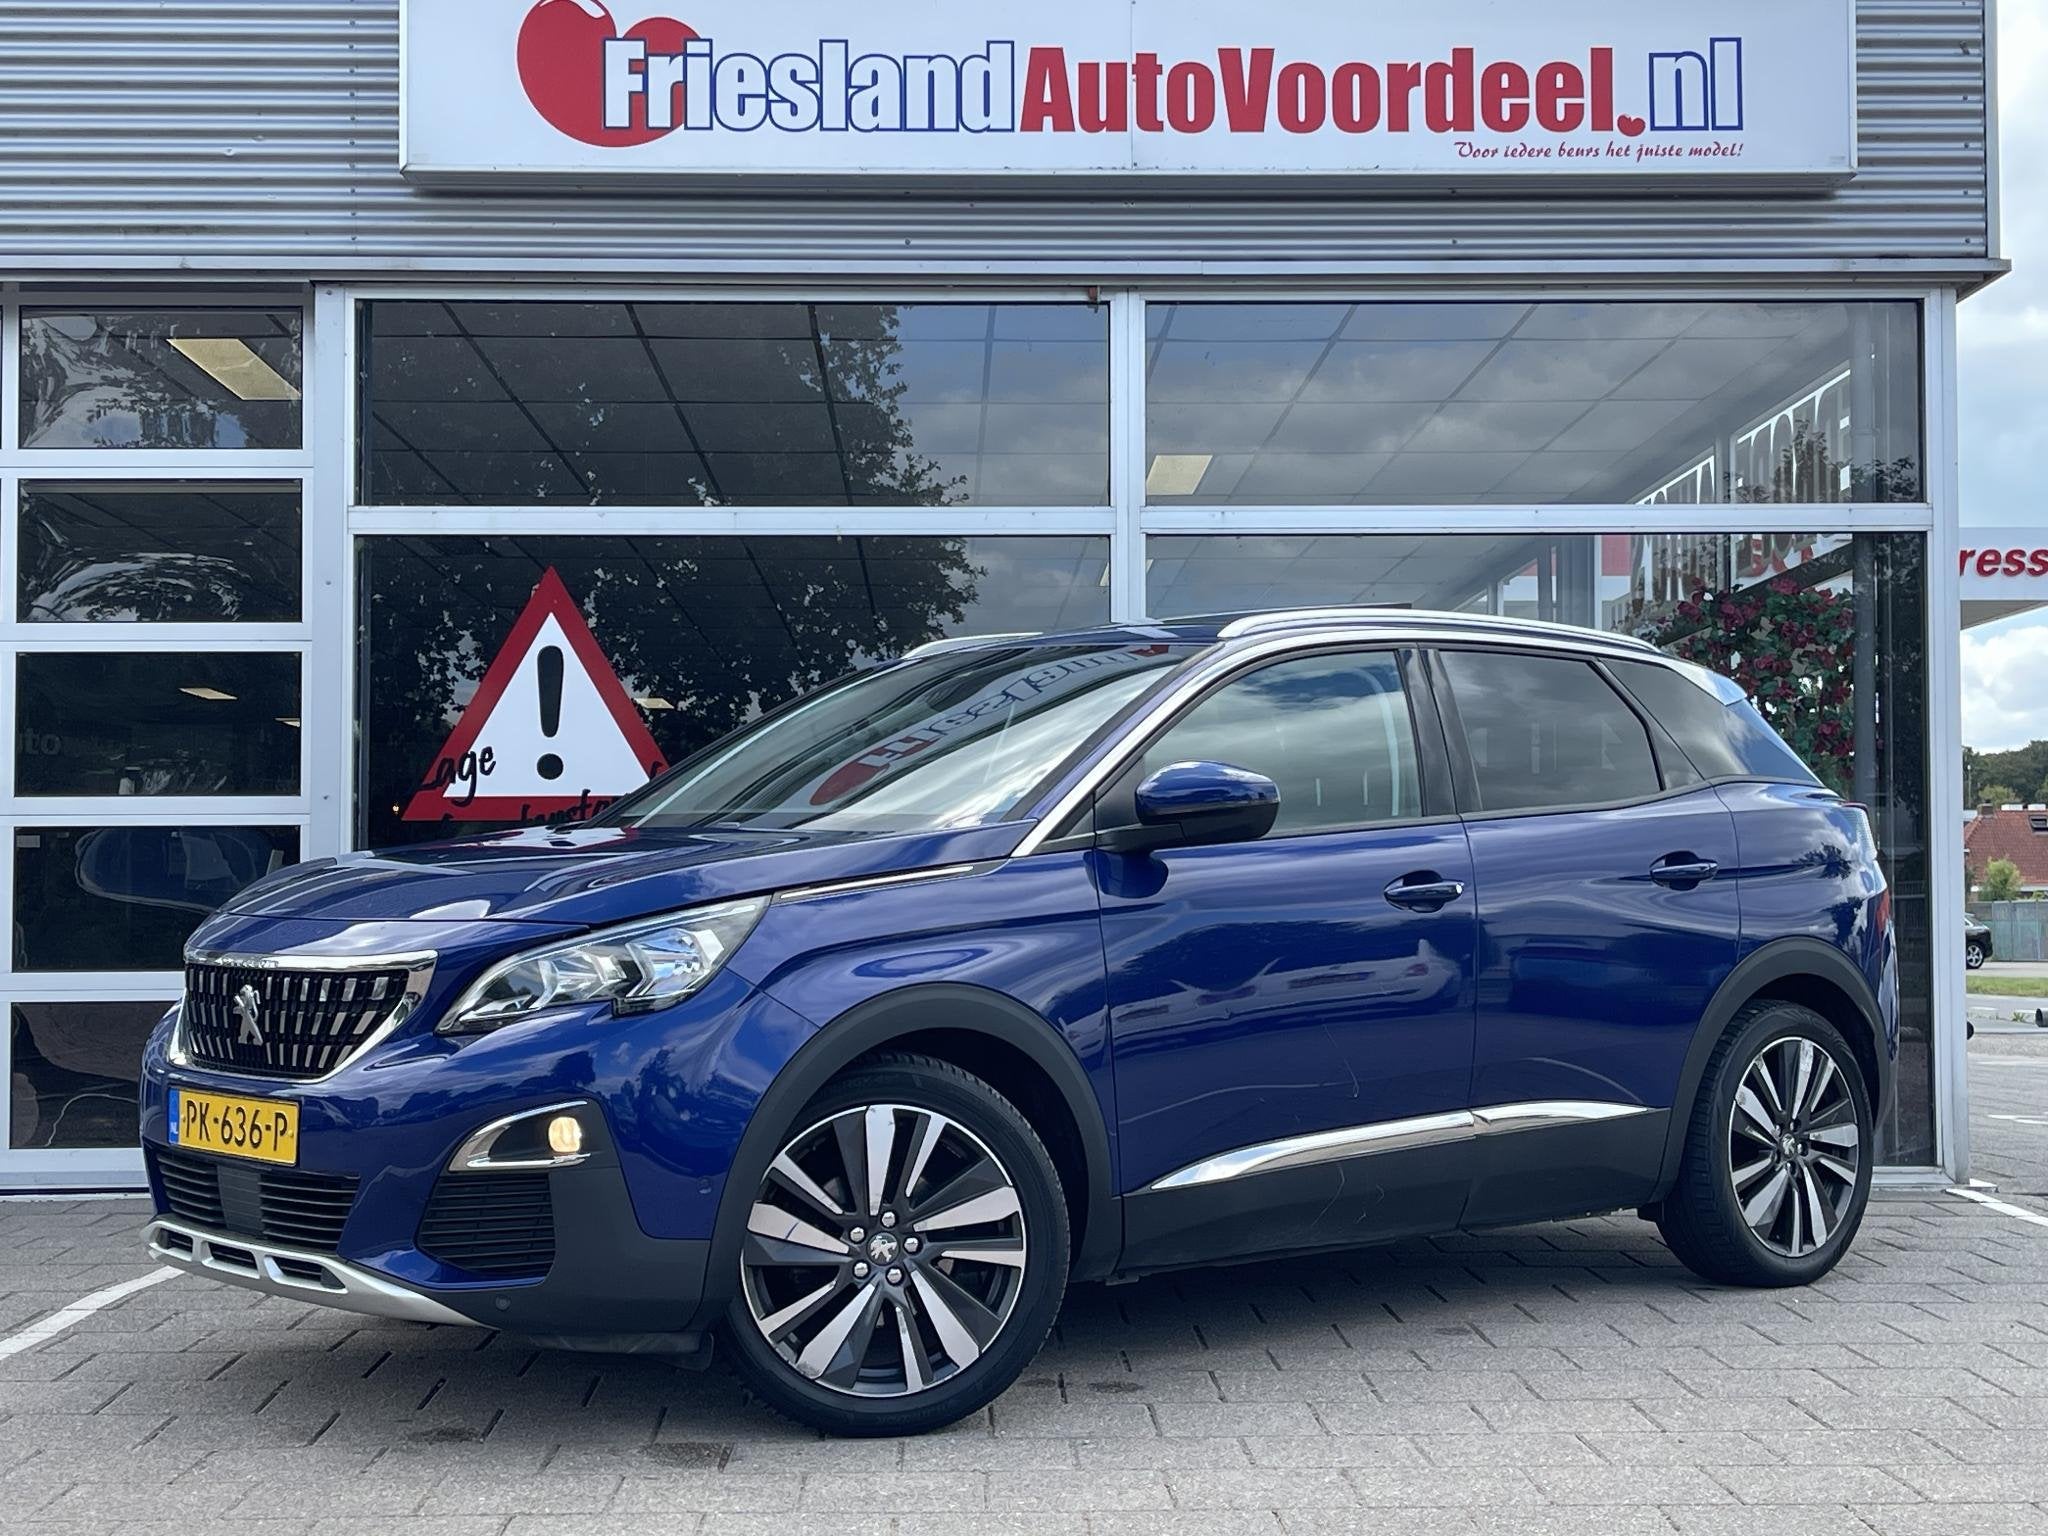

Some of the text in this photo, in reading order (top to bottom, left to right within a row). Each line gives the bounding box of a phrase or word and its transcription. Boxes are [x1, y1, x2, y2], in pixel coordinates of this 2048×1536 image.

[1454, 141, 1743, 162] Voor iedere beurs het juiste model!
[186, 1100, 288, 1151] PK-636-P
